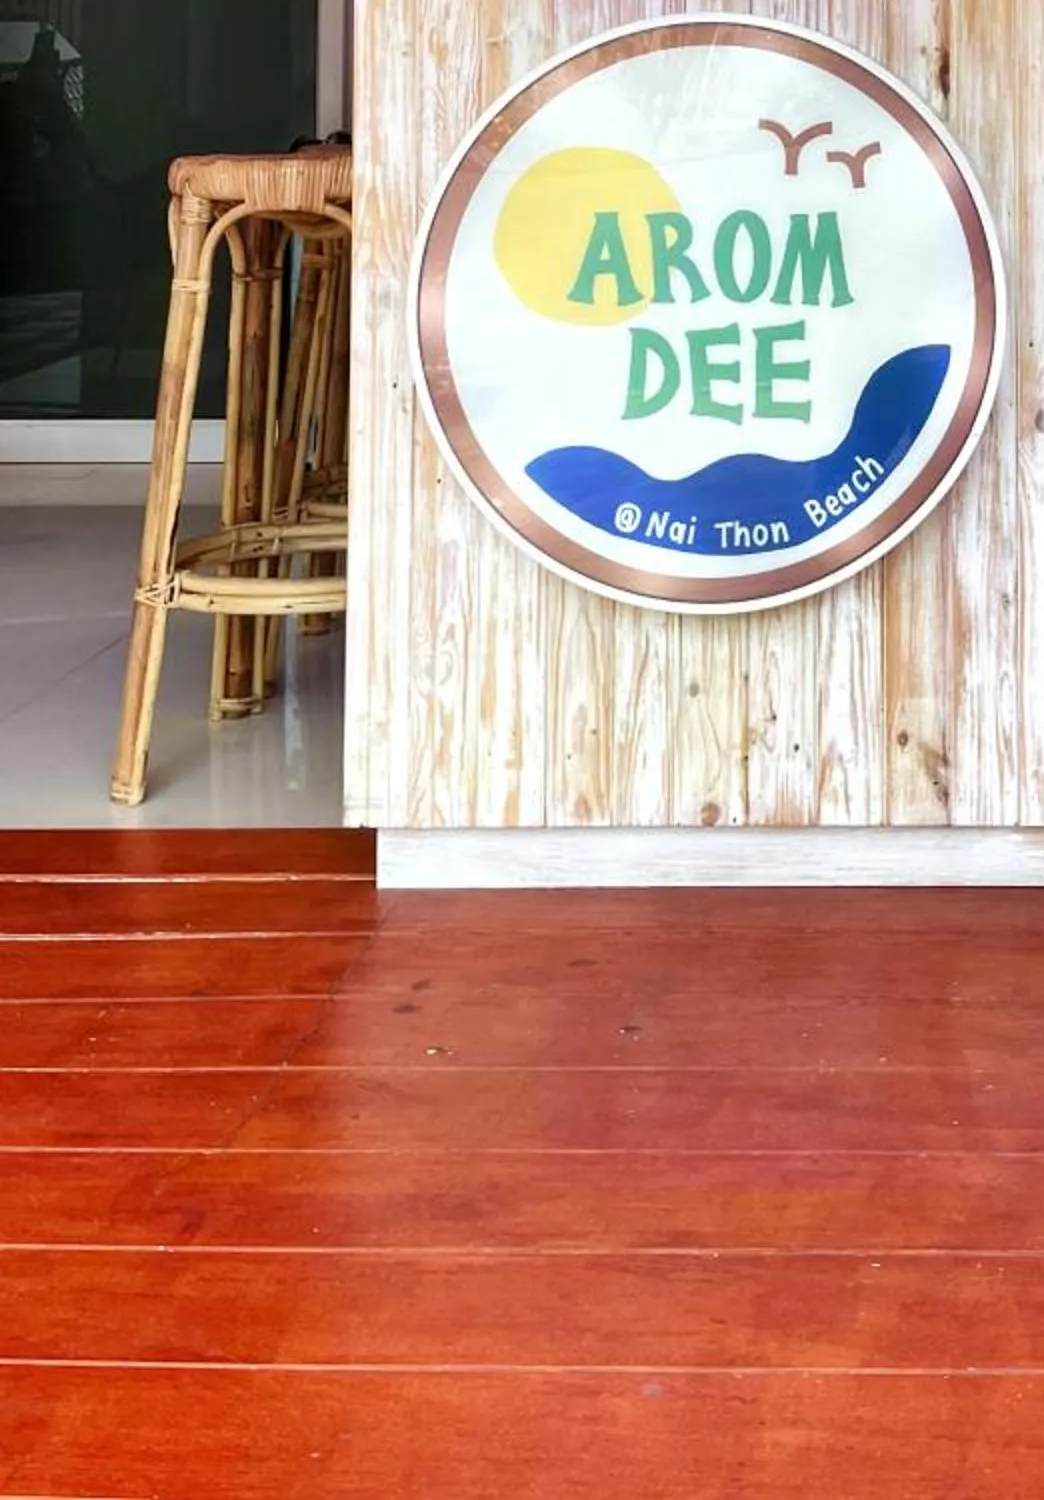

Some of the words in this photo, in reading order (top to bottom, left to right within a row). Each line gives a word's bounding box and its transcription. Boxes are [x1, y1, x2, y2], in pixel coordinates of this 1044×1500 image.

[566, 209, 855, 309] AROM
[620, 320, 812, 425] DEE
[714, 520, 791, 549] Thon
[802, 455, 886, 530] Beach
